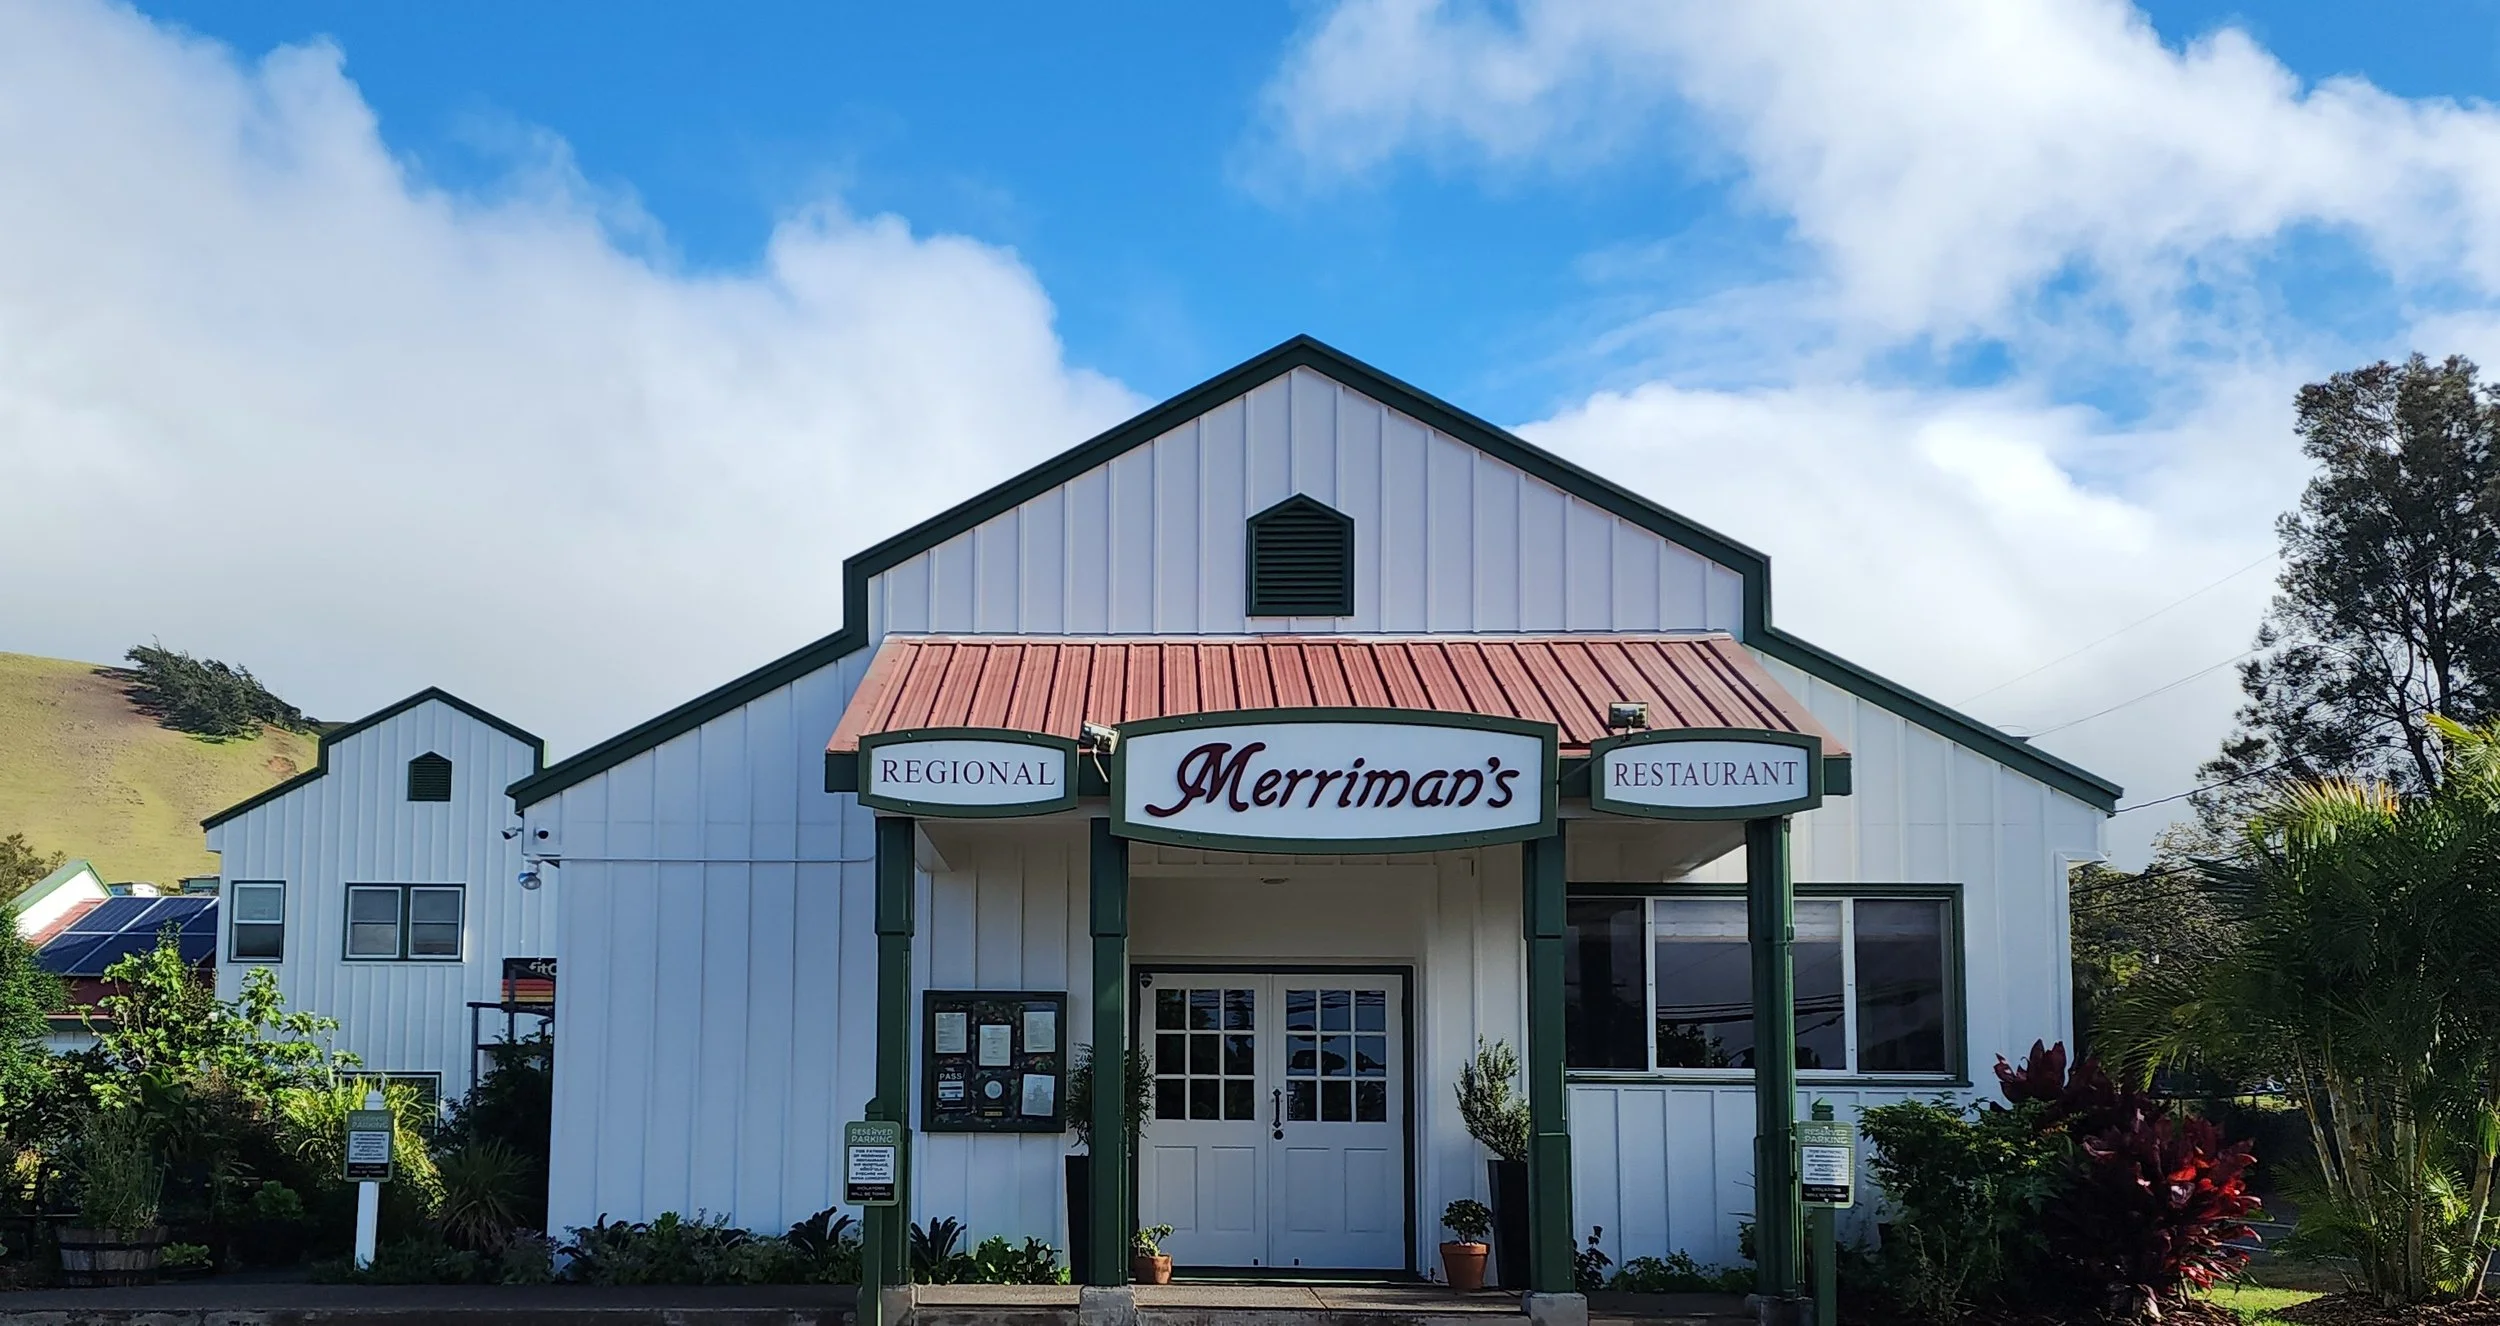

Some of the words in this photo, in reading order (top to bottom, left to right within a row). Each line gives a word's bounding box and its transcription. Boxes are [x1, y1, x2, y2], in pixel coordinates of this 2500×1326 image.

[881, 759, 1055, 786] REGIONAL
[1144, 742, 1520, 818] Merriman's
[1614, 761, 1798, 787] RESTAURANT
[851, 1128, 893, 1136] RESERVED
[1804, 1136, 1849, 1144] PARKING
